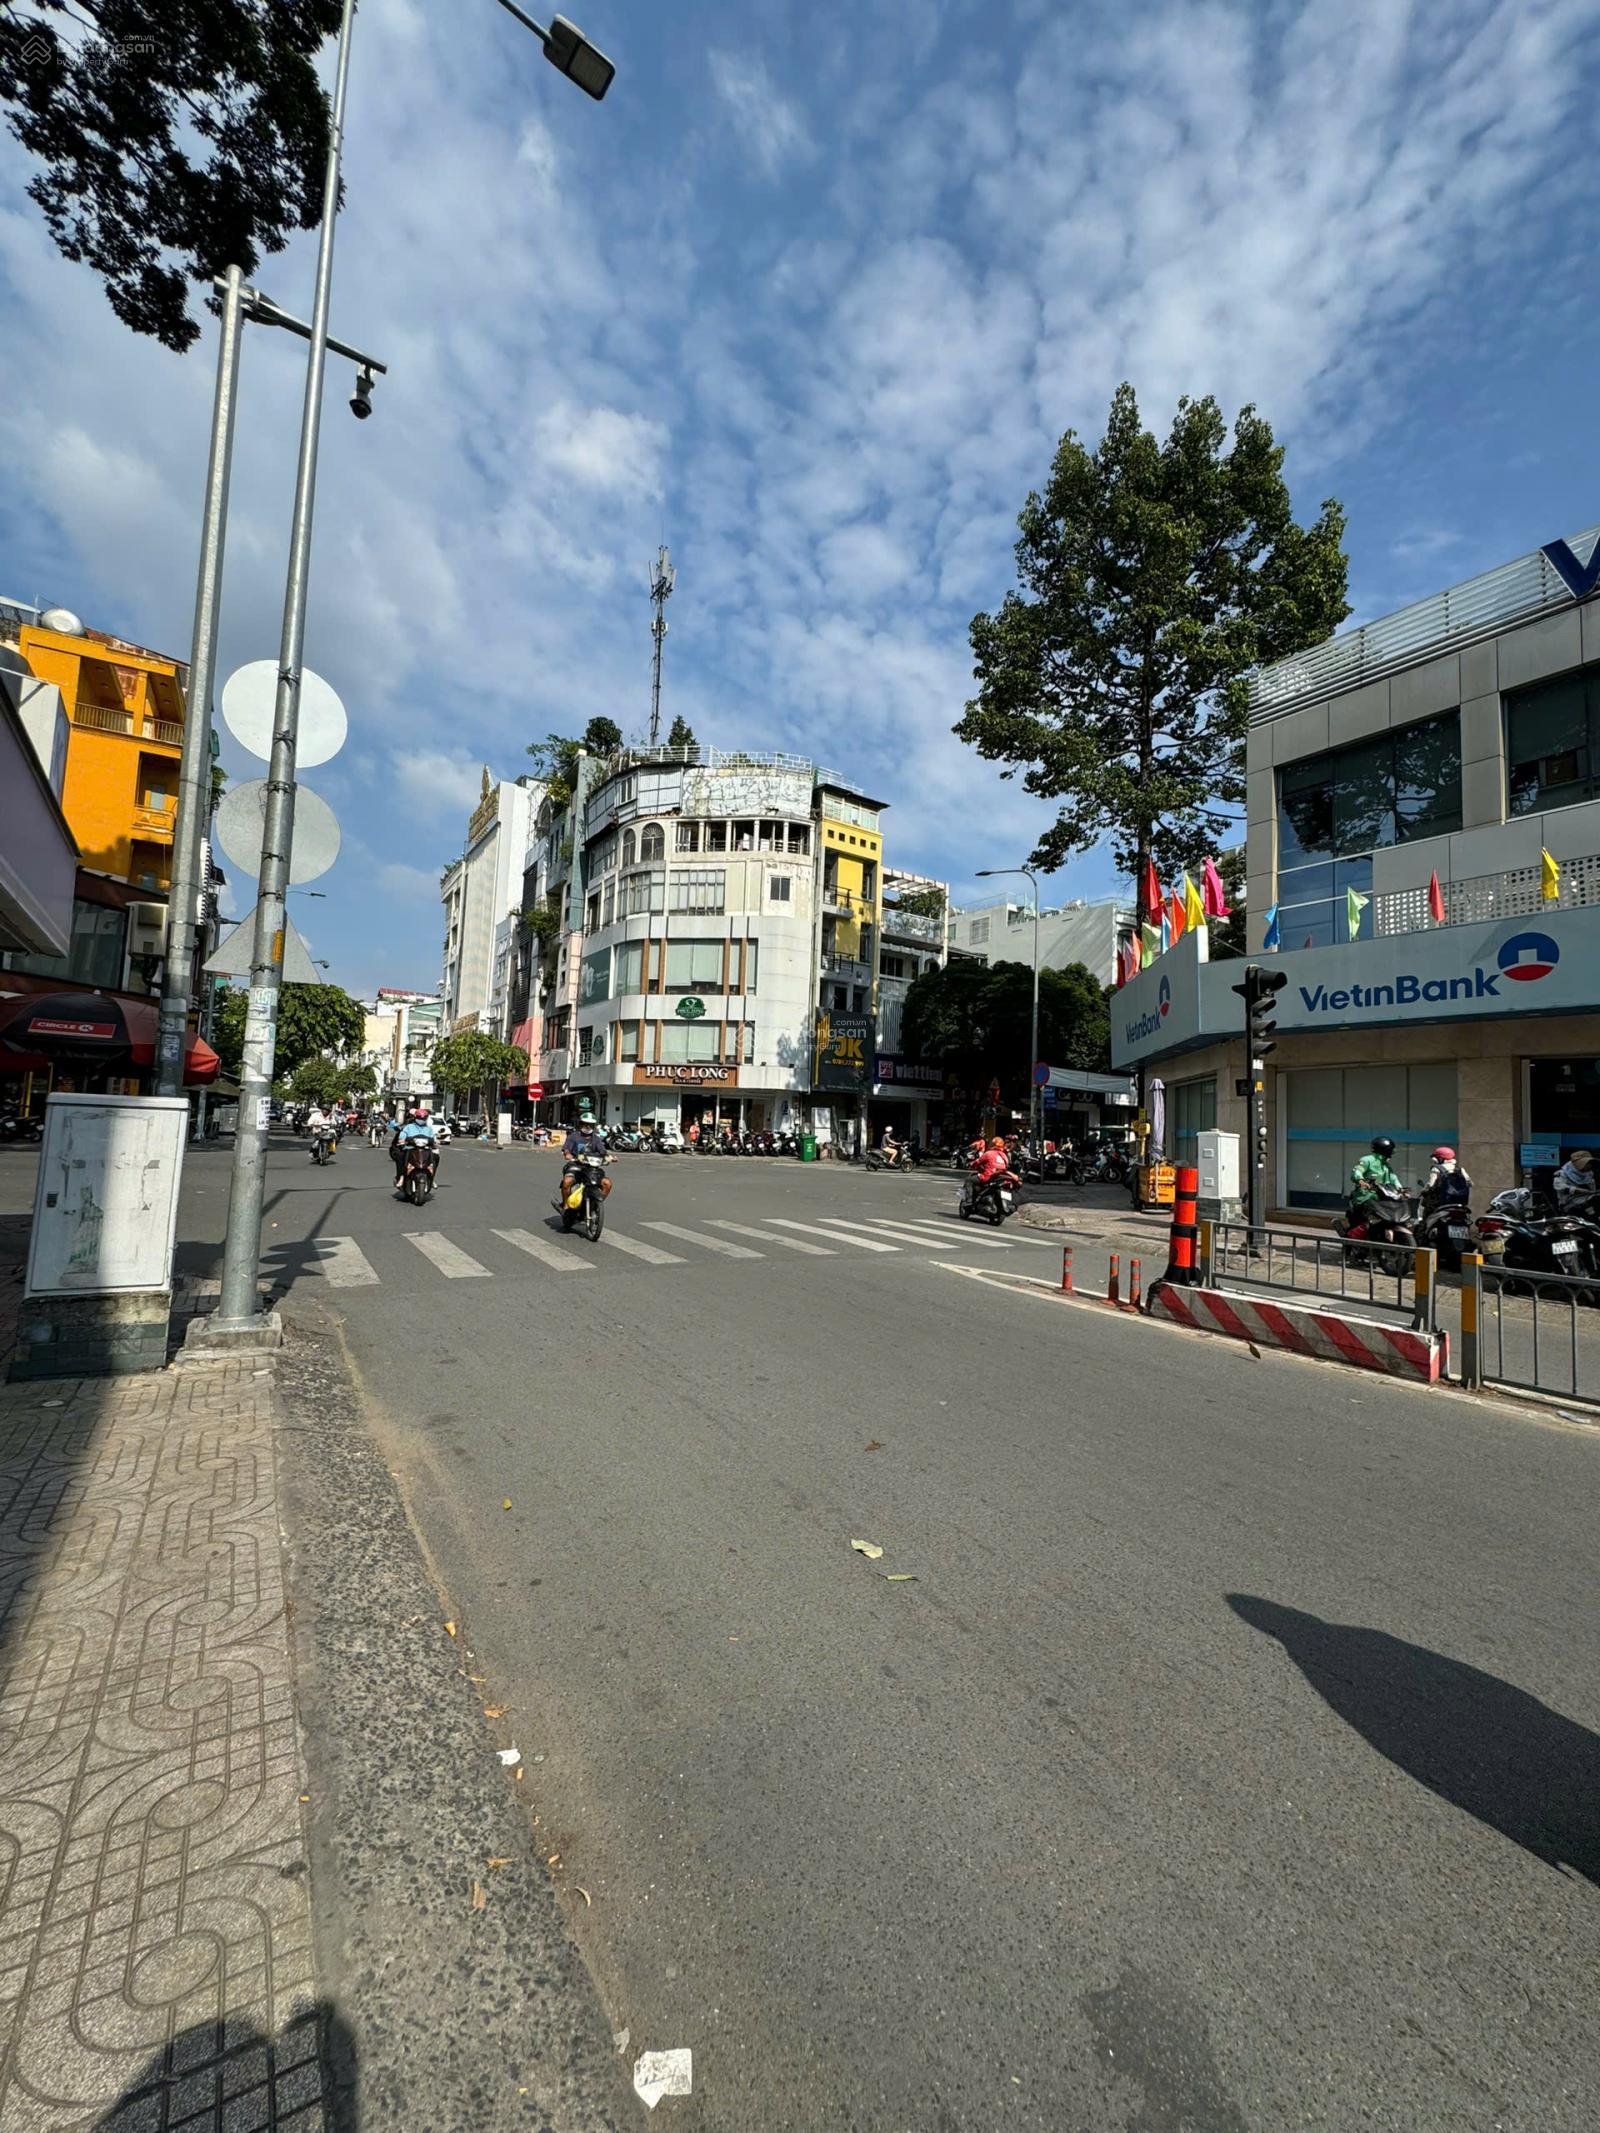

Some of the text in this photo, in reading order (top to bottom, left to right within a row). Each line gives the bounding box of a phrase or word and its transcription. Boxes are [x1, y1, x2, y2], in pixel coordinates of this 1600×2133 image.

[1299, 968, 1501, 1012] VietinBank
[37, 1021, 77, 1030] CIRCLE
[645, 1065, 729, 1080] PHUC LONG
